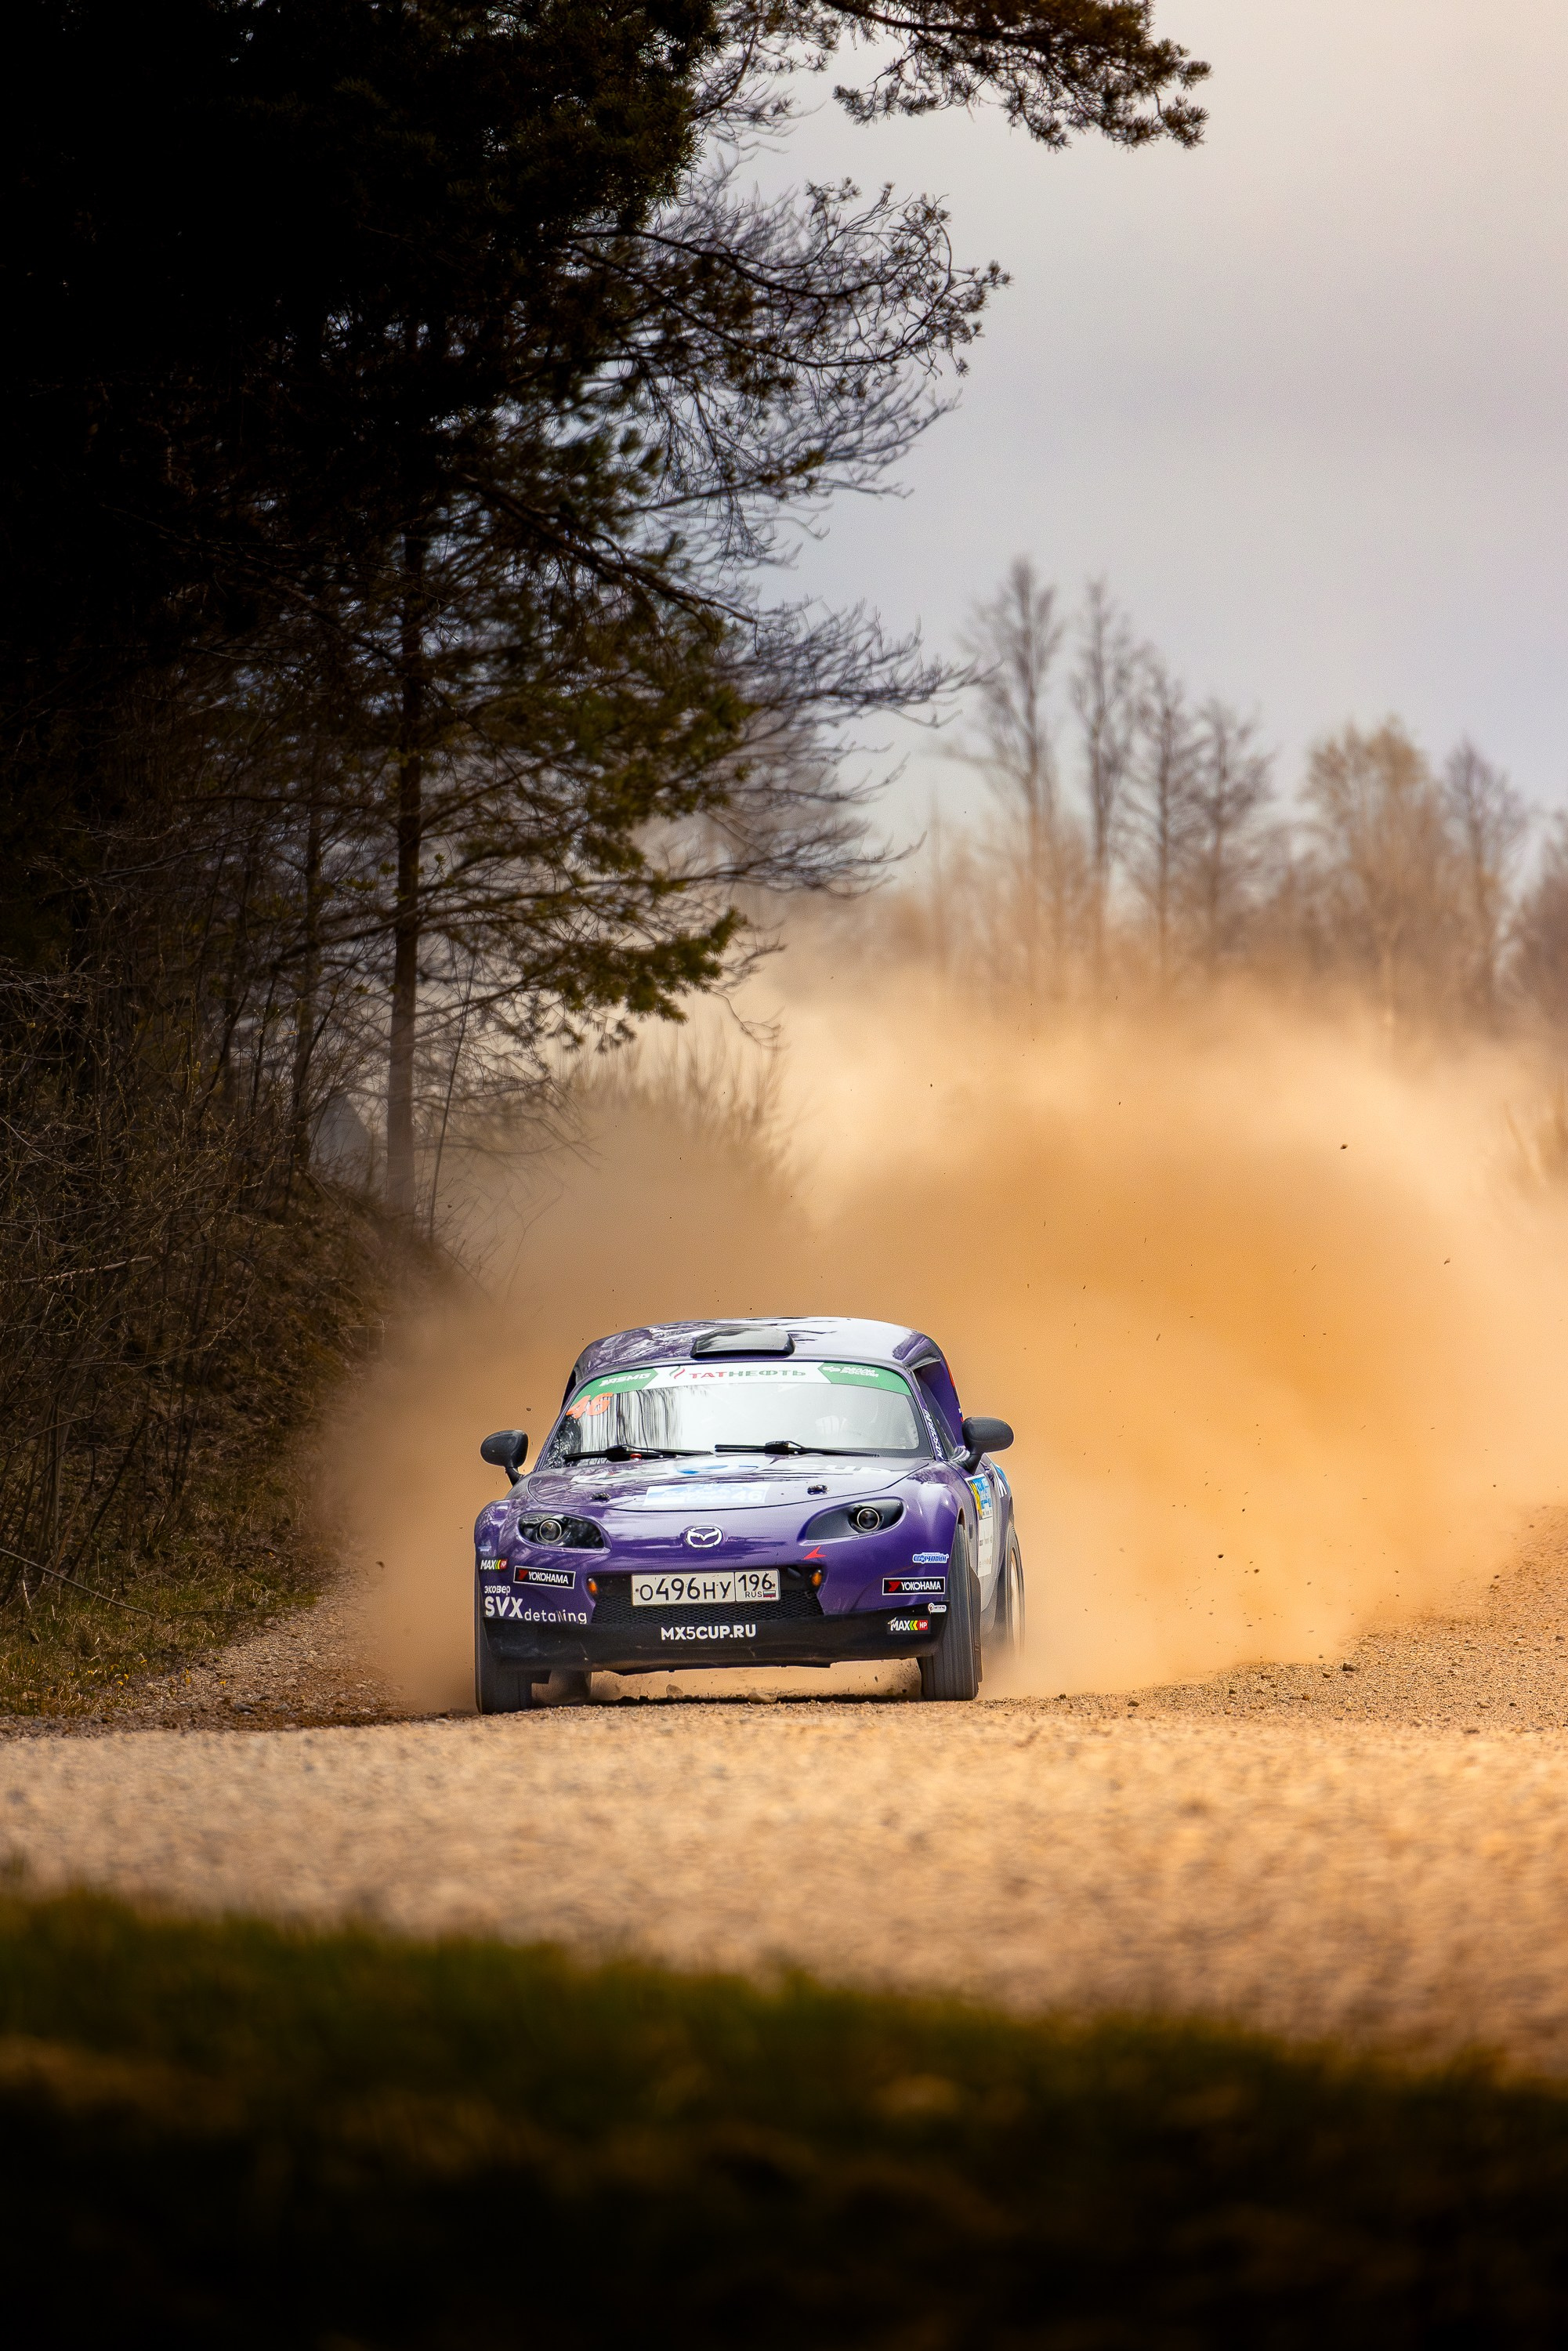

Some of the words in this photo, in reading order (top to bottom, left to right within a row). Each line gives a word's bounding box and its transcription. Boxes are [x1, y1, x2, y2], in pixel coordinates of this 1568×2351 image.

[689, 1369, 806, 1378] ТАТНЕФТЬ
[566, 1392, 614, 1419] 46
[731, 1490, 762, 1501] 46
[480, 1559, 496, 1570] MAX
[529, 1571, 569, 1584] YOKOHAMA
[738, 1574, 773, 1592] 196
[484, 1585, 511, 1596] эковер
[901, 1581, 941, 1591] YOKOHAMA
[484, 1596, 523, 1619] SVX
[890, 1620, 911, 1631] MAX
[661, 1624, 757, 1641] MX5CUP.RU
